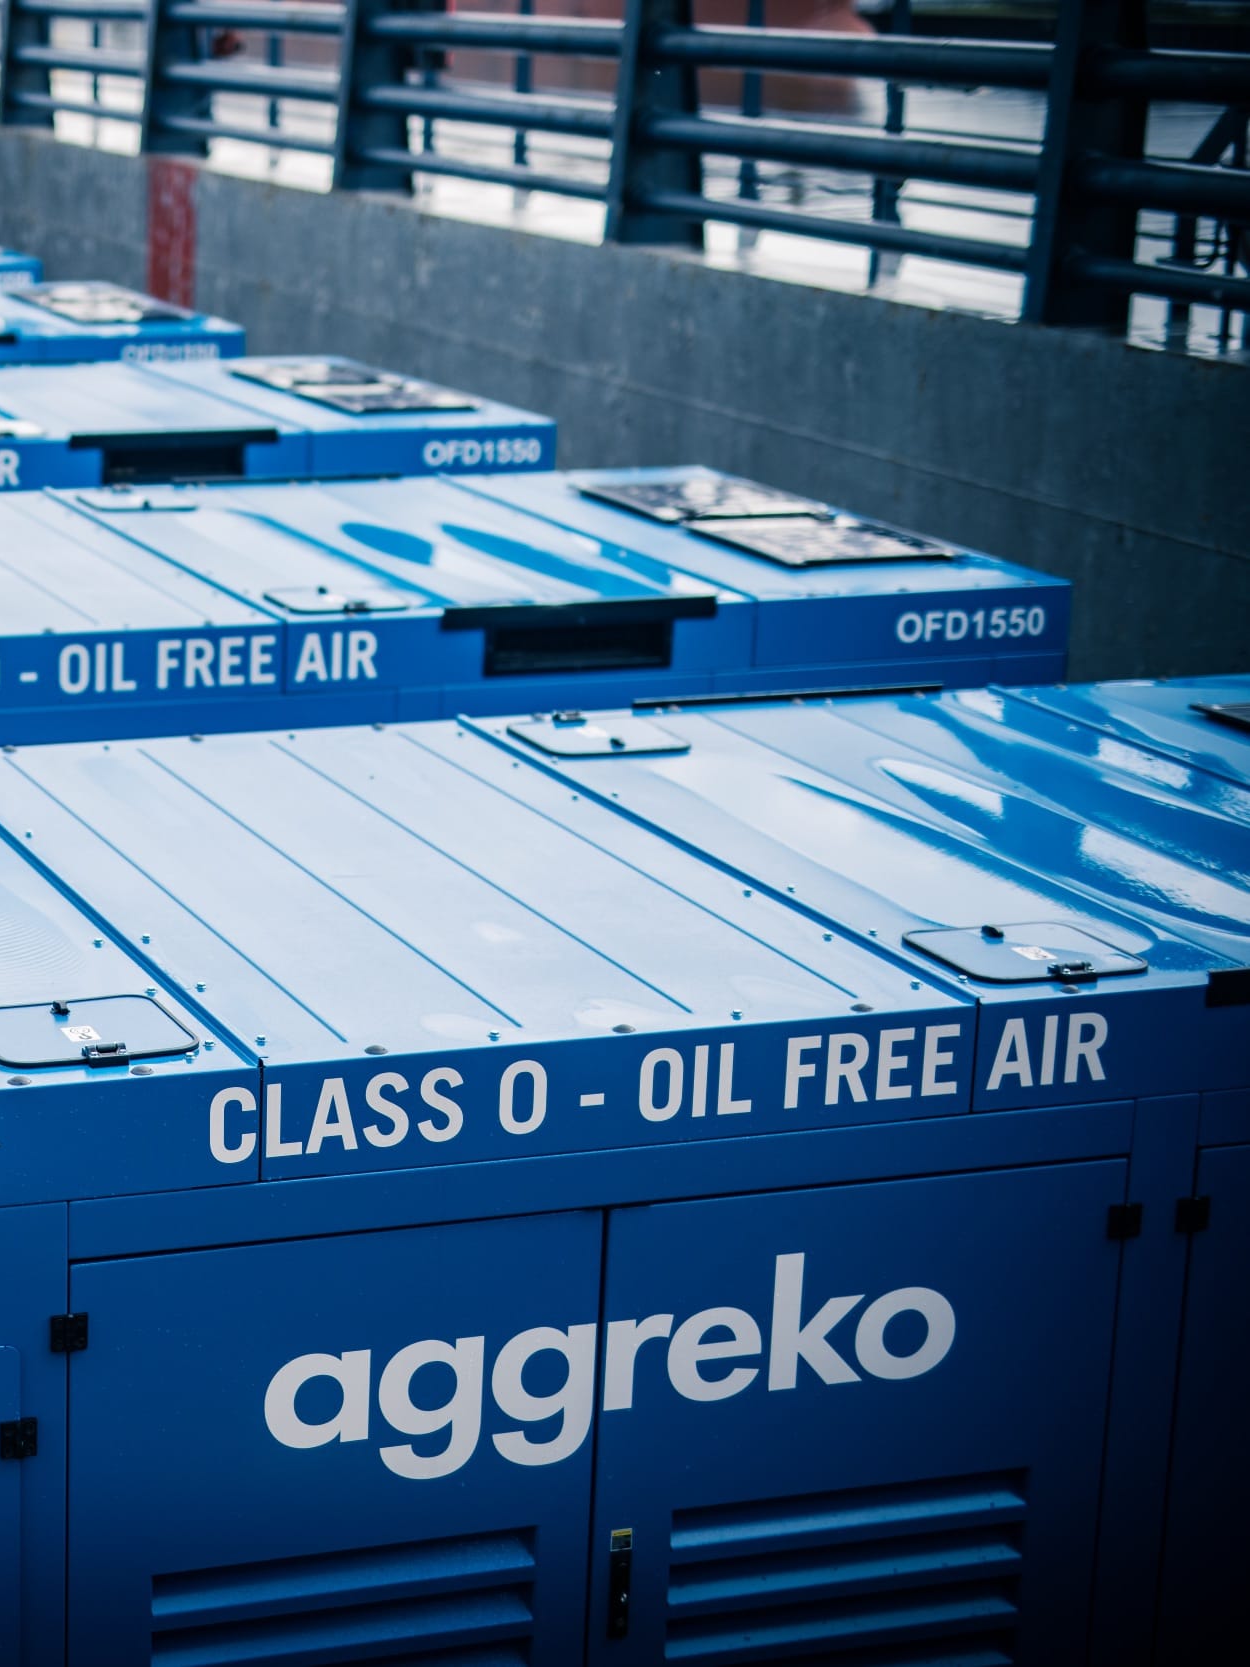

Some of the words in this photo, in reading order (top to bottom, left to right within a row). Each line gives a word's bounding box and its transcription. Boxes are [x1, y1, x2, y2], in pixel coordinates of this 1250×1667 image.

[423, 438, 542, 466] OFD1550
[896, 607, 1045, 643] OFD1550
[59, 642, 136, 694] OIL
[157, 635, 277, 689] FREE
[295, 630, 378, 682] AIR
[209, 1068, 464, 1164] CLASS
[638, 1042, 752, 1122] OIL
[784, 1023, 961, 1109] FREE
[986, 1012, 1108, 1090] AIR
[263, 1252, 956, 1480] aggreko
